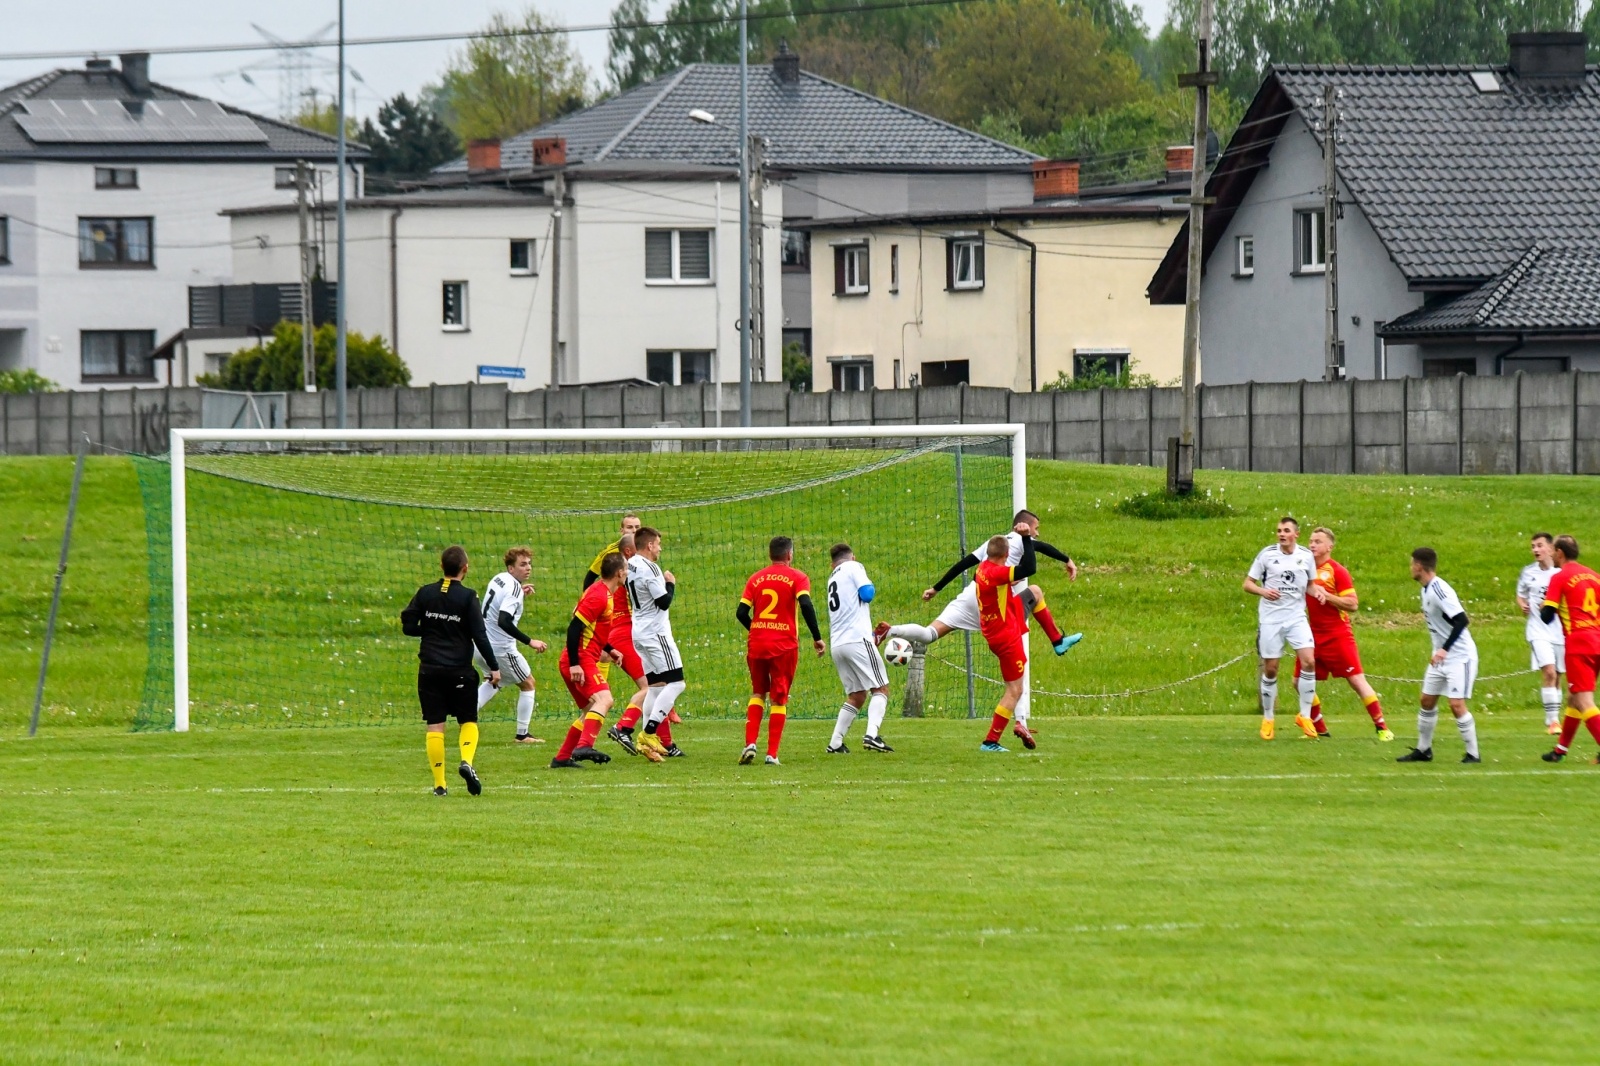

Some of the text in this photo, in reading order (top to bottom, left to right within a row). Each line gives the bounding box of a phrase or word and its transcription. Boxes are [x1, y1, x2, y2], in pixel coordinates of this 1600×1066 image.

[752, 573, 794, 587] LKS ZGODA
[483, 588, 495, 618] 7
[759, 588, 779, 620] 2
[828, 581, 840, 612] 3
[1582, 587, 1600, 618] 4
[592, 673, 606, 685] 13
[1016, 659, 1024, 673] 3
